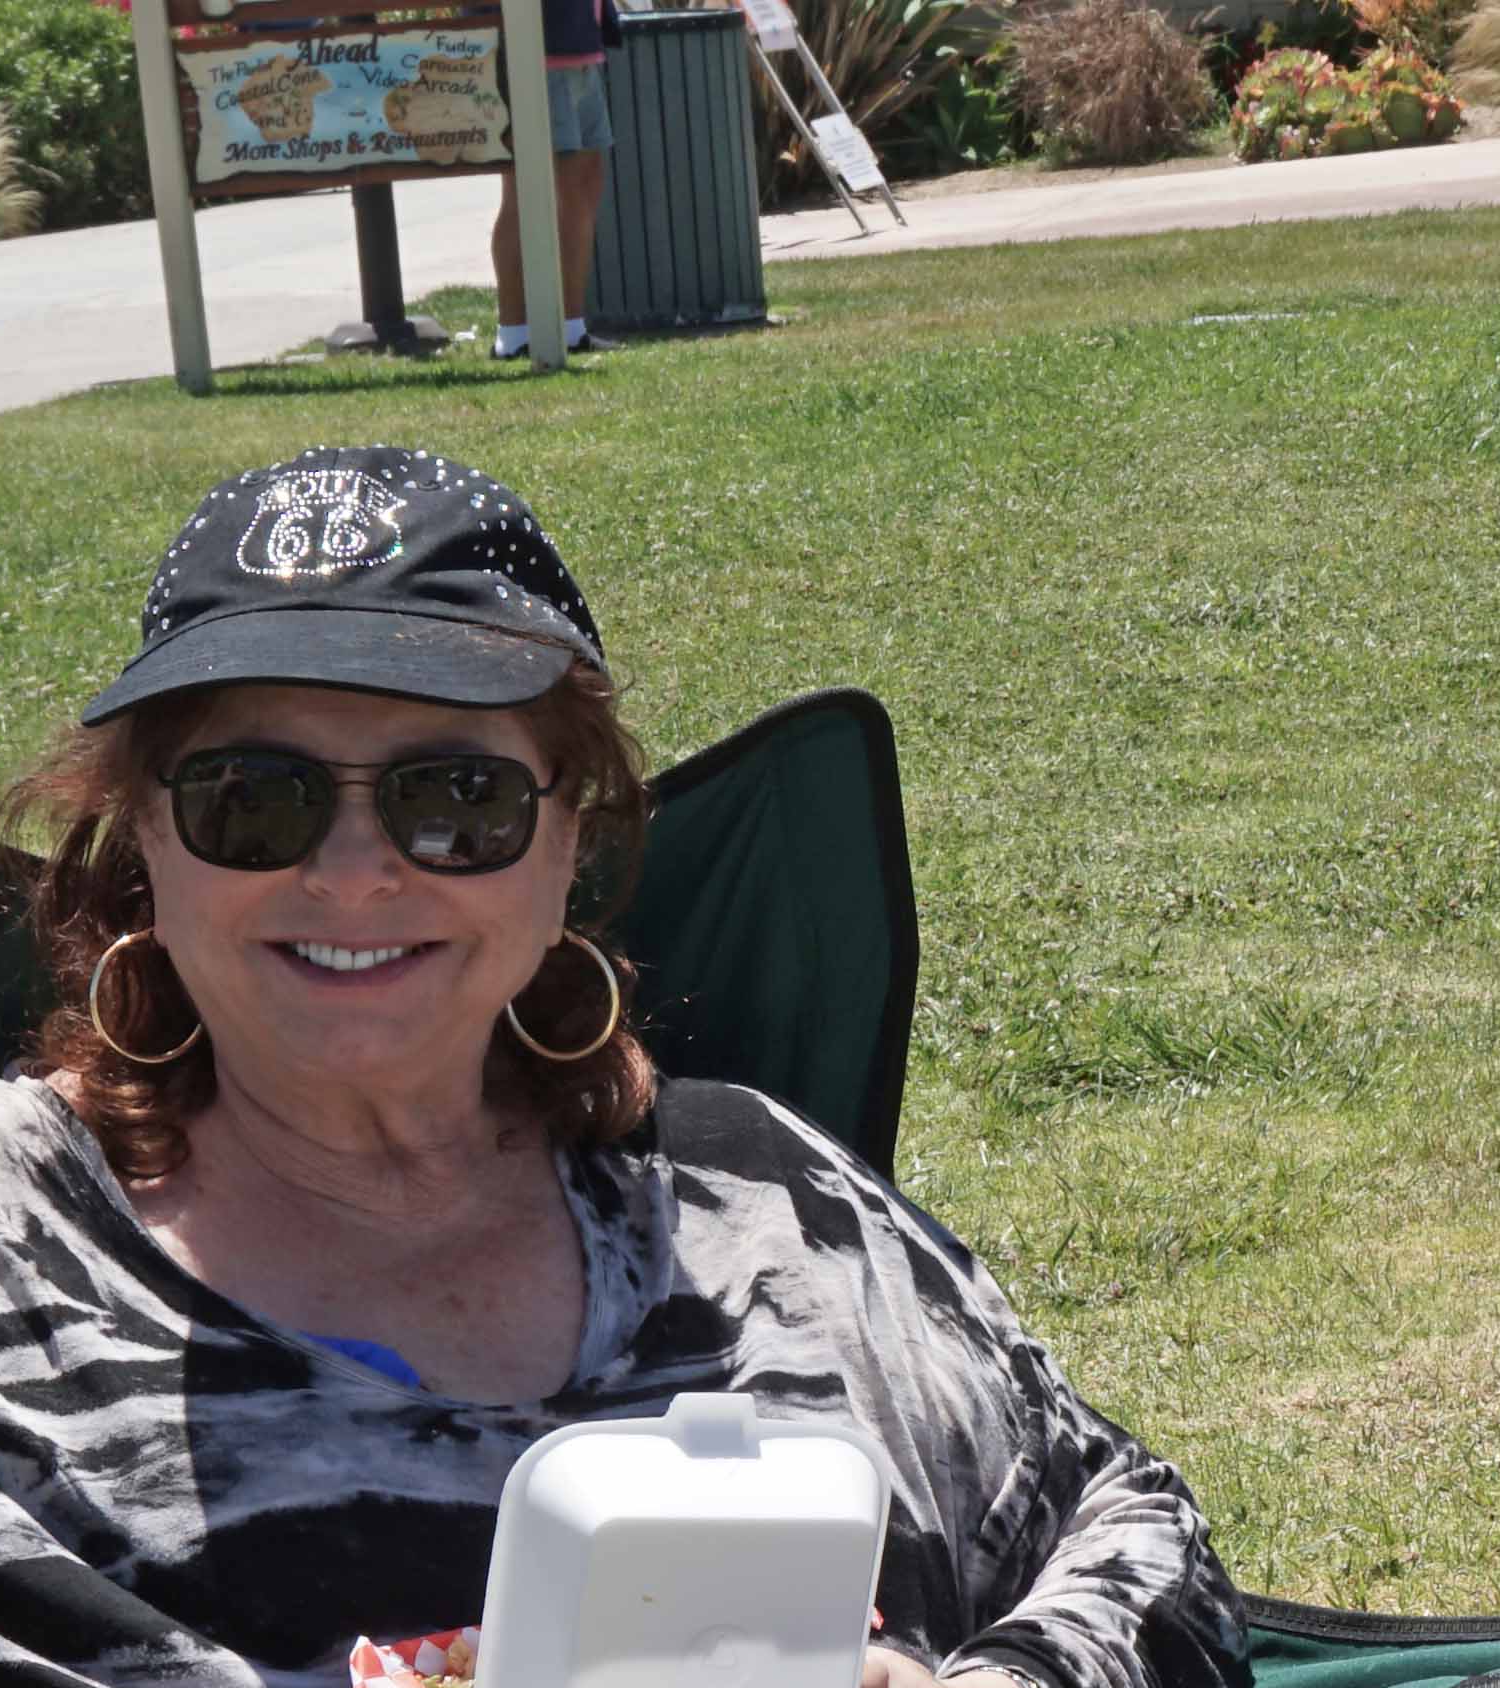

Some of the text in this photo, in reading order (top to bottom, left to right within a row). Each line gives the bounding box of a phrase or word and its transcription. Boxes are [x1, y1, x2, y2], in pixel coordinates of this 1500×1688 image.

[287, 33, 380, 70] Ahead
[435, 35, 483, 60] Fudge
[208, 66, 235, 84] The
[401, 53, 485, 74] Carousel
[359, 65, 479, 95] Video Arcade
[223, 127, 488, 163] More Shops & Restaurants
[267, 505, 369, 567] 66
